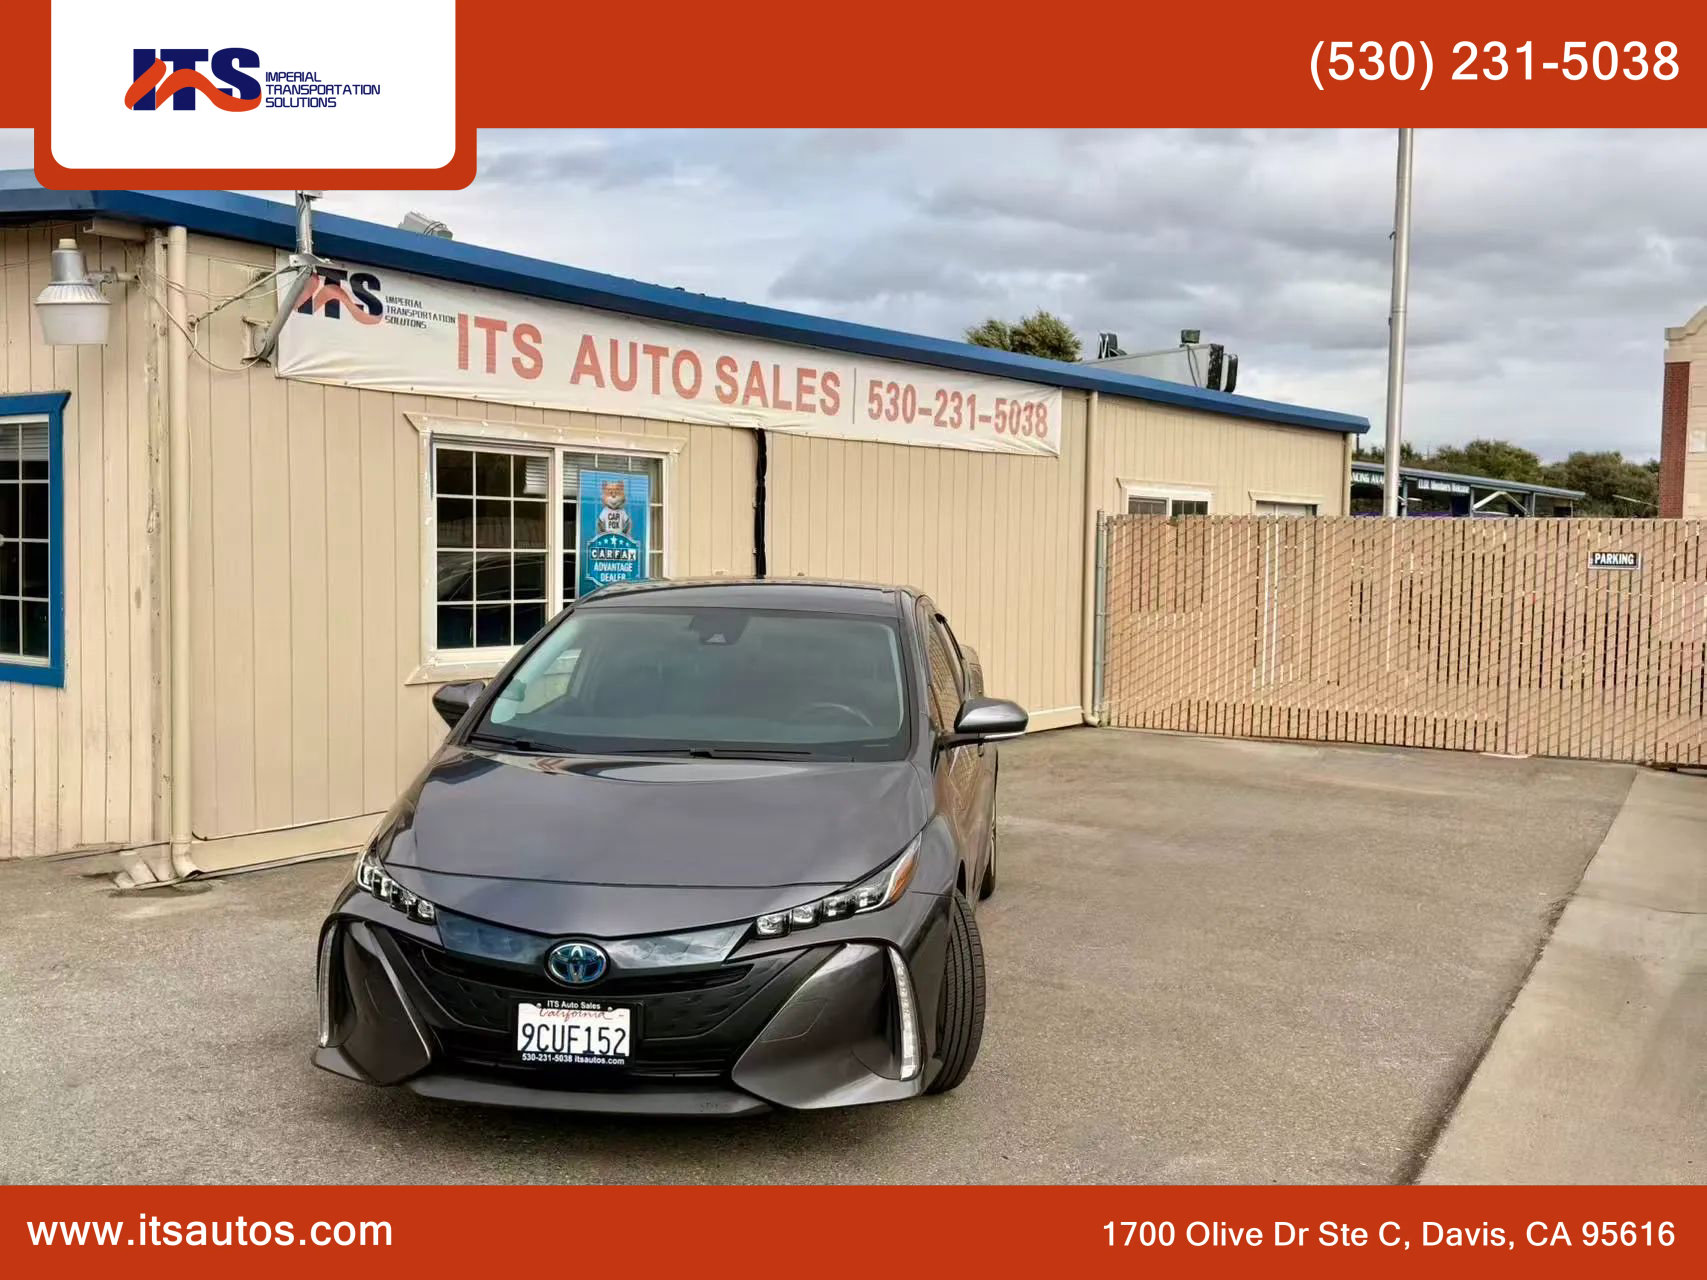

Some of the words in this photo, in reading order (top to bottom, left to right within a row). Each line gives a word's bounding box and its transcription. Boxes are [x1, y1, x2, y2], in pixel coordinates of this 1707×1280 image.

[385, 296, 423, 309] IMPERIAL
[386, 305, 456, 324] TRANSPORTATION
[457, 313, 543, 380] ITS
[570, 334, 702, 399] AUTO
[714, 355, 841, 416] SALES
[868, 379, 1048, 439] 530-231-5038
[591, 549, 637, 560] CARFAX
[1594, 552, 1635, 565] PARKING
[593, 562, 633, 572] ADVANTAGE
[600, 573, 626, 582] DEALER
[547, 1000, 560, 1008] ITS
[561, 1001, 579, 1009] Auto
[581, 1002, 601, 1010] Sales
[521, 1022, 626, 1056] 9CUF152
[522, 1053, 573, 1063] 530-231-5038
[574, 1055, 625, 1065] itsautos.com
